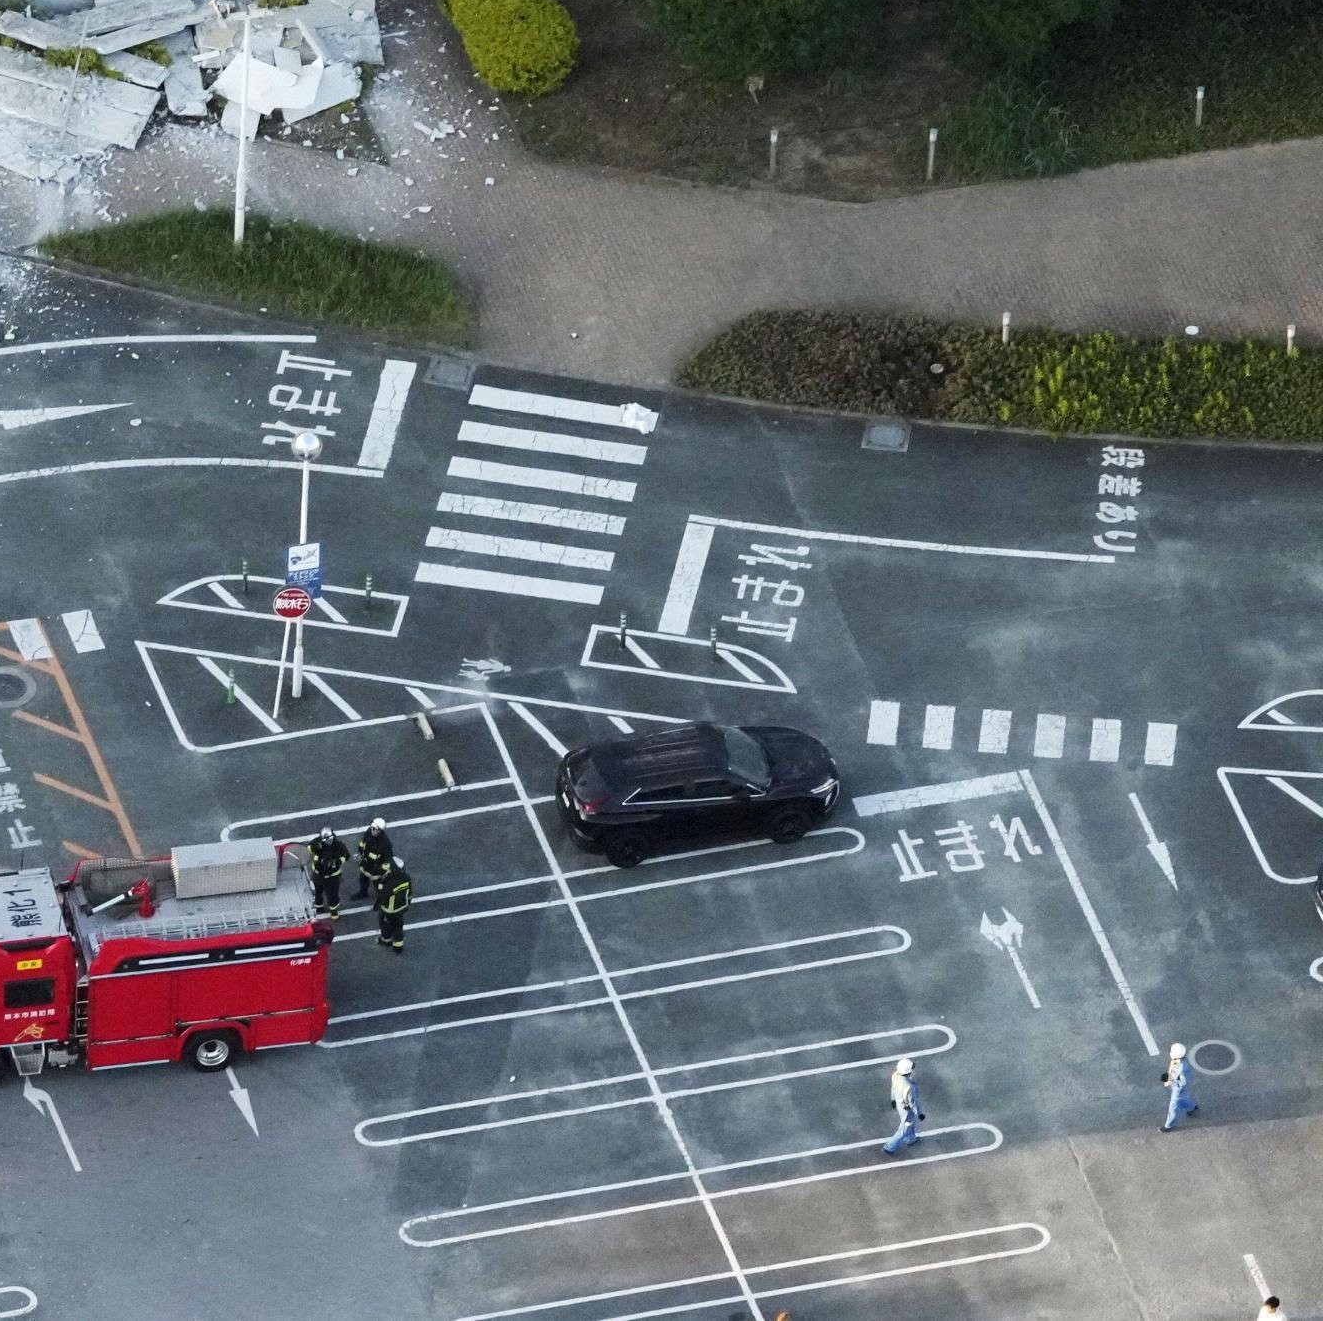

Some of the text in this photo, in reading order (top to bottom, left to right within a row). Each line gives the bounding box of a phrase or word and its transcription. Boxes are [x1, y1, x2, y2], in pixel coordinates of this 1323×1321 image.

[1093, 445, 1146, 553] 段差あり
[721, 543, 813, 643] 止まれ
[891, 813, 1043, 883] 止まれ
